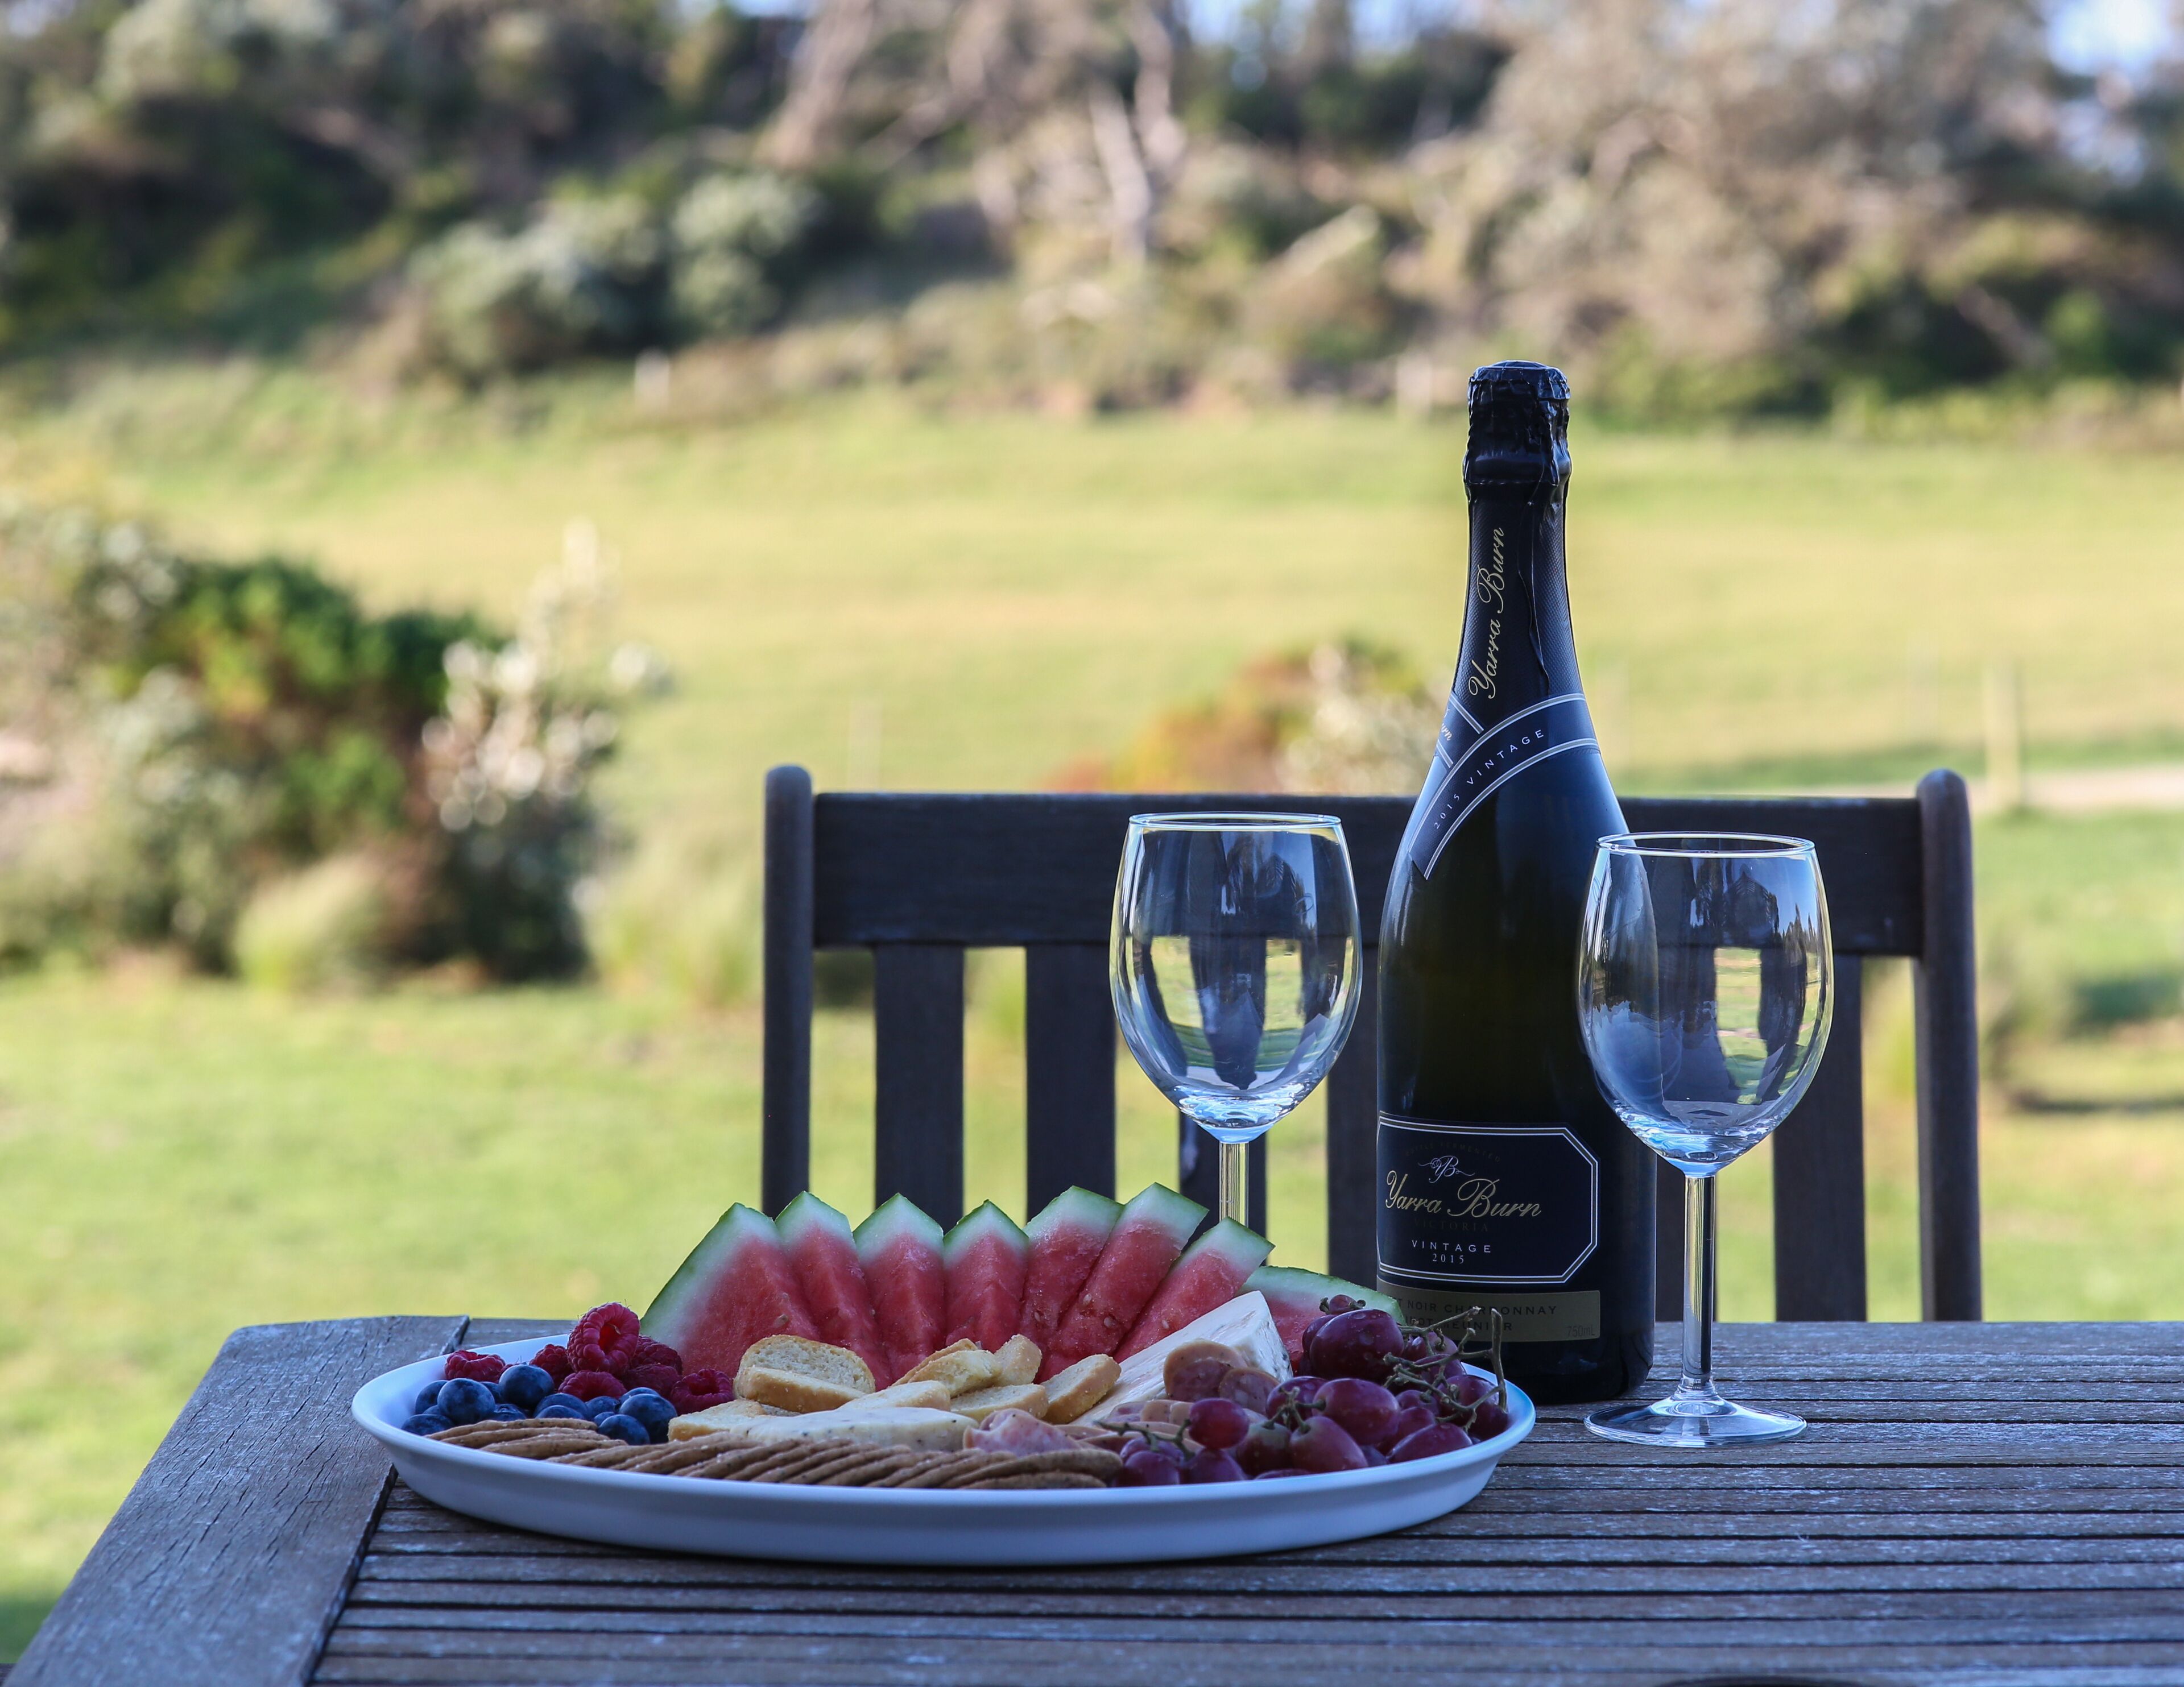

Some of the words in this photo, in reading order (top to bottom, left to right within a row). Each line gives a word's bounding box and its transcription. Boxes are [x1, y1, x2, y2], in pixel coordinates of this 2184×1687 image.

[1477, 528, 1504, 615] Burn
[1469, 619, 1500, 699] Yarra
[1434, 794, 1460, 829] 2015
[1467, 729, 1544, 785] VINTAGE
[1385, 1170, 1442, 1213] Yarra
[1446, 1178, 1542, 1218] Burn
[1412, 1240, 1491, 1253] VINTAGE
[1432, 1253, 1465, 1265] 2015
[1408, 1300, 1437, 1312] NOIR
[1566, 1325, 1595, 1337] 750mL
